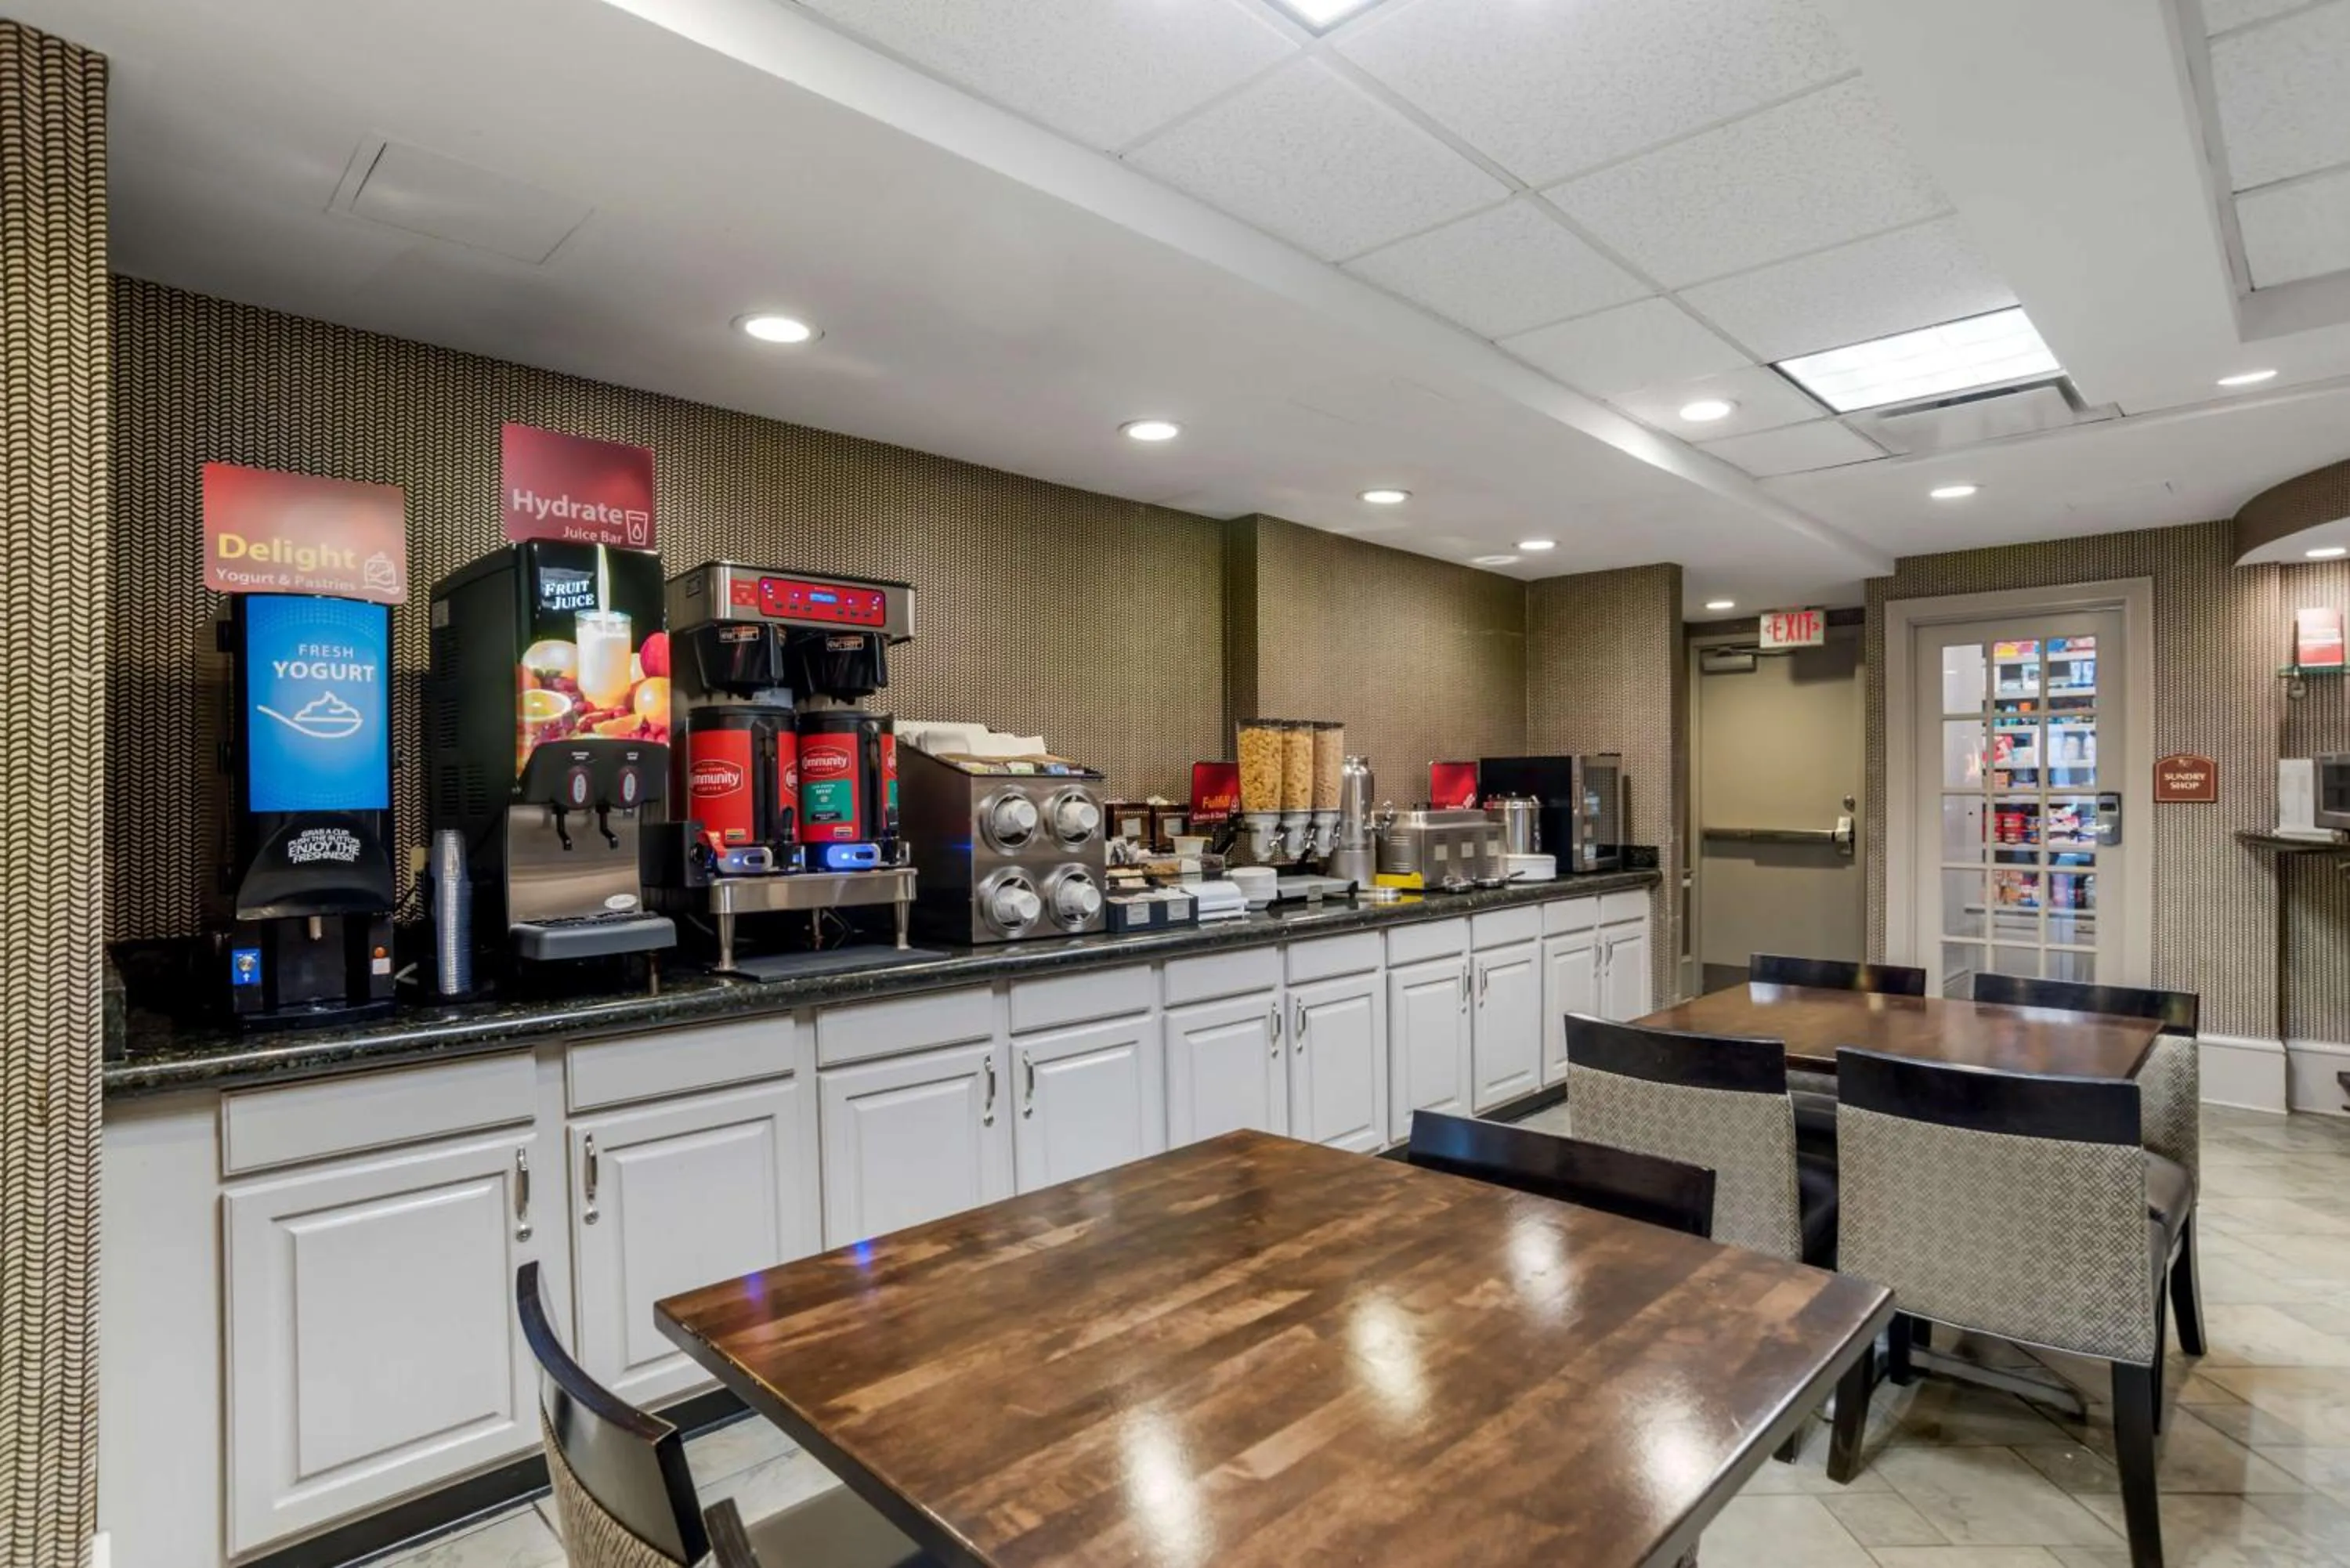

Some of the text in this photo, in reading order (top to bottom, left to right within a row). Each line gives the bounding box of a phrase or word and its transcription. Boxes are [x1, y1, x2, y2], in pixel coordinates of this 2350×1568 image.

[513, 489, 624, 525] Hydrate
[563, 526, 624, 545] Juice Bar
[218, 533, 356, 573] Delight
[215, 567, 356, 591] Yogurt & Pastries
[544, 580, 590, 597] FRUIT
[551, 594, 595, 611] JUICE
[1773, 612, 1814, 641] EXIT
[298, 644, 354, 659] FRESH
[273, 660, 375, 683] YOGURT
[2164, 772, 2207, 781] SUNDRY
[2169, 781, 2200, 790] SHOP
[288, 841, 360, 858] ENJOY THE
